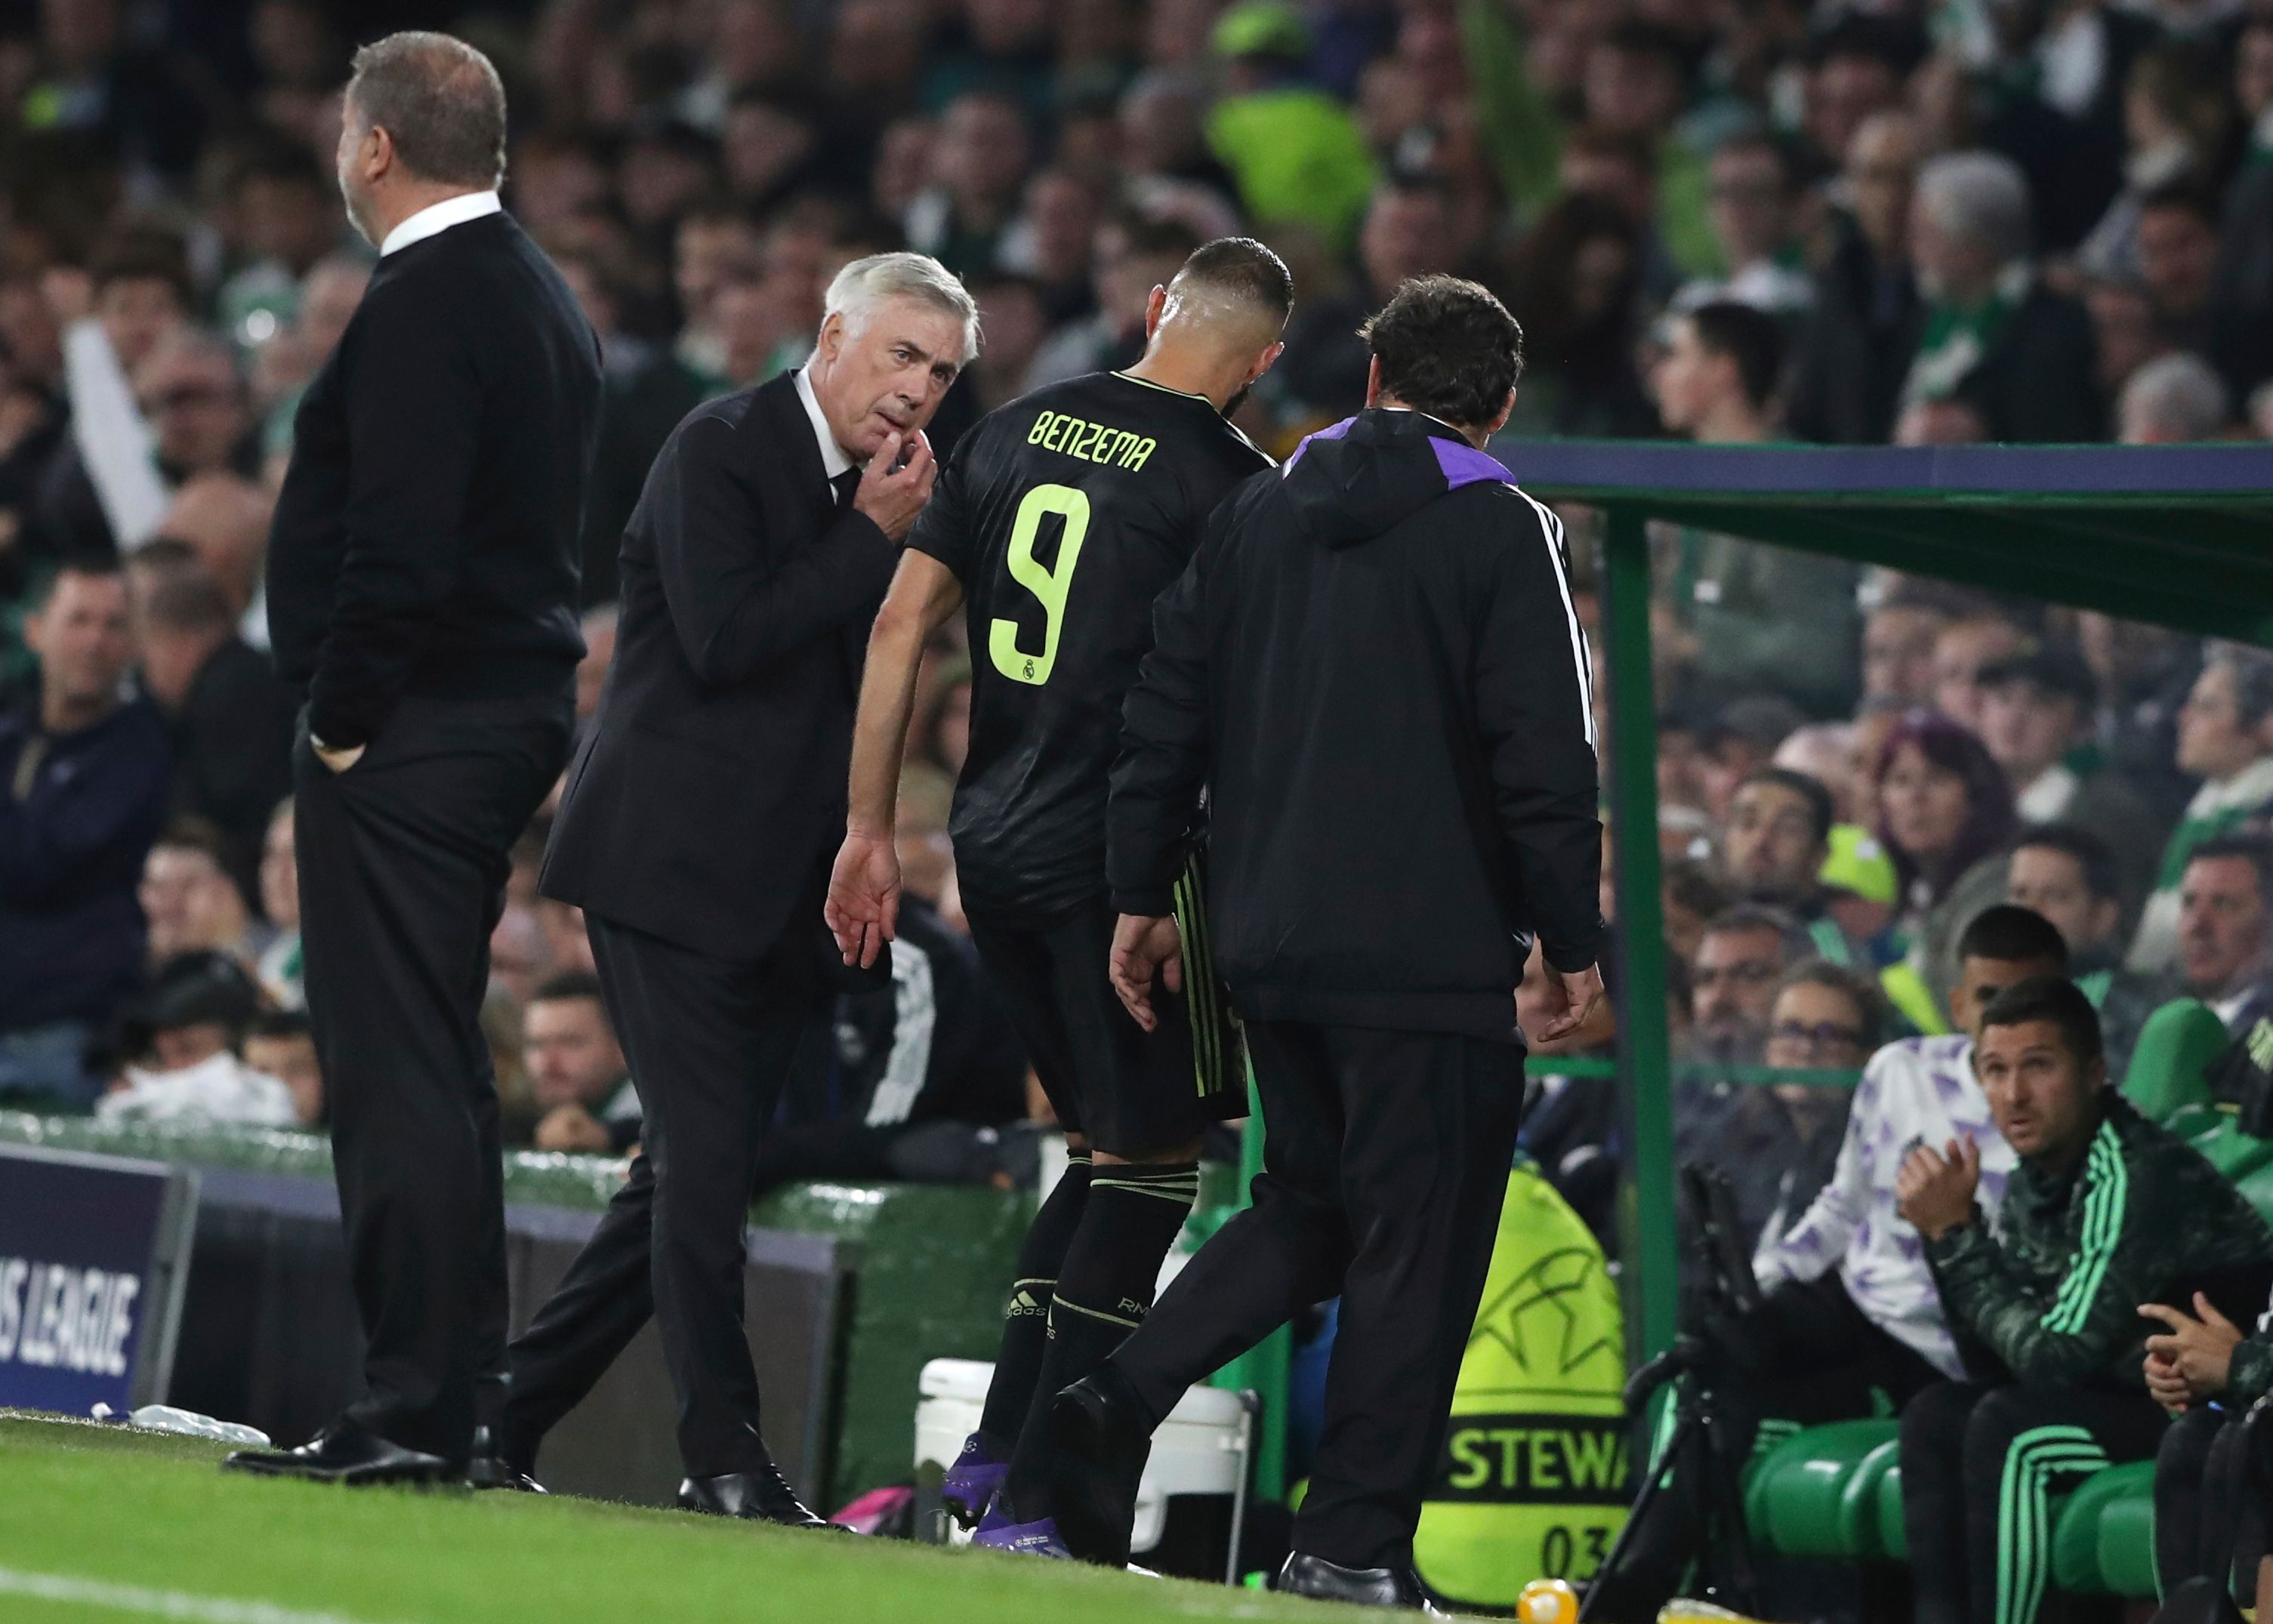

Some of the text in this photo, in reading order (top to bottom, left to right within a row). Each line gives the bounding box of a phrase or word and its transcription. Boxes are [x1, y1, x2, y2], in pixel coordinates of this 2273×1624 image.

[1027, 410, 1157, 473] BENZEMA
[988, 483, 1090, 686] 9
[19, 1261, 140, 1377] LEAGUE
